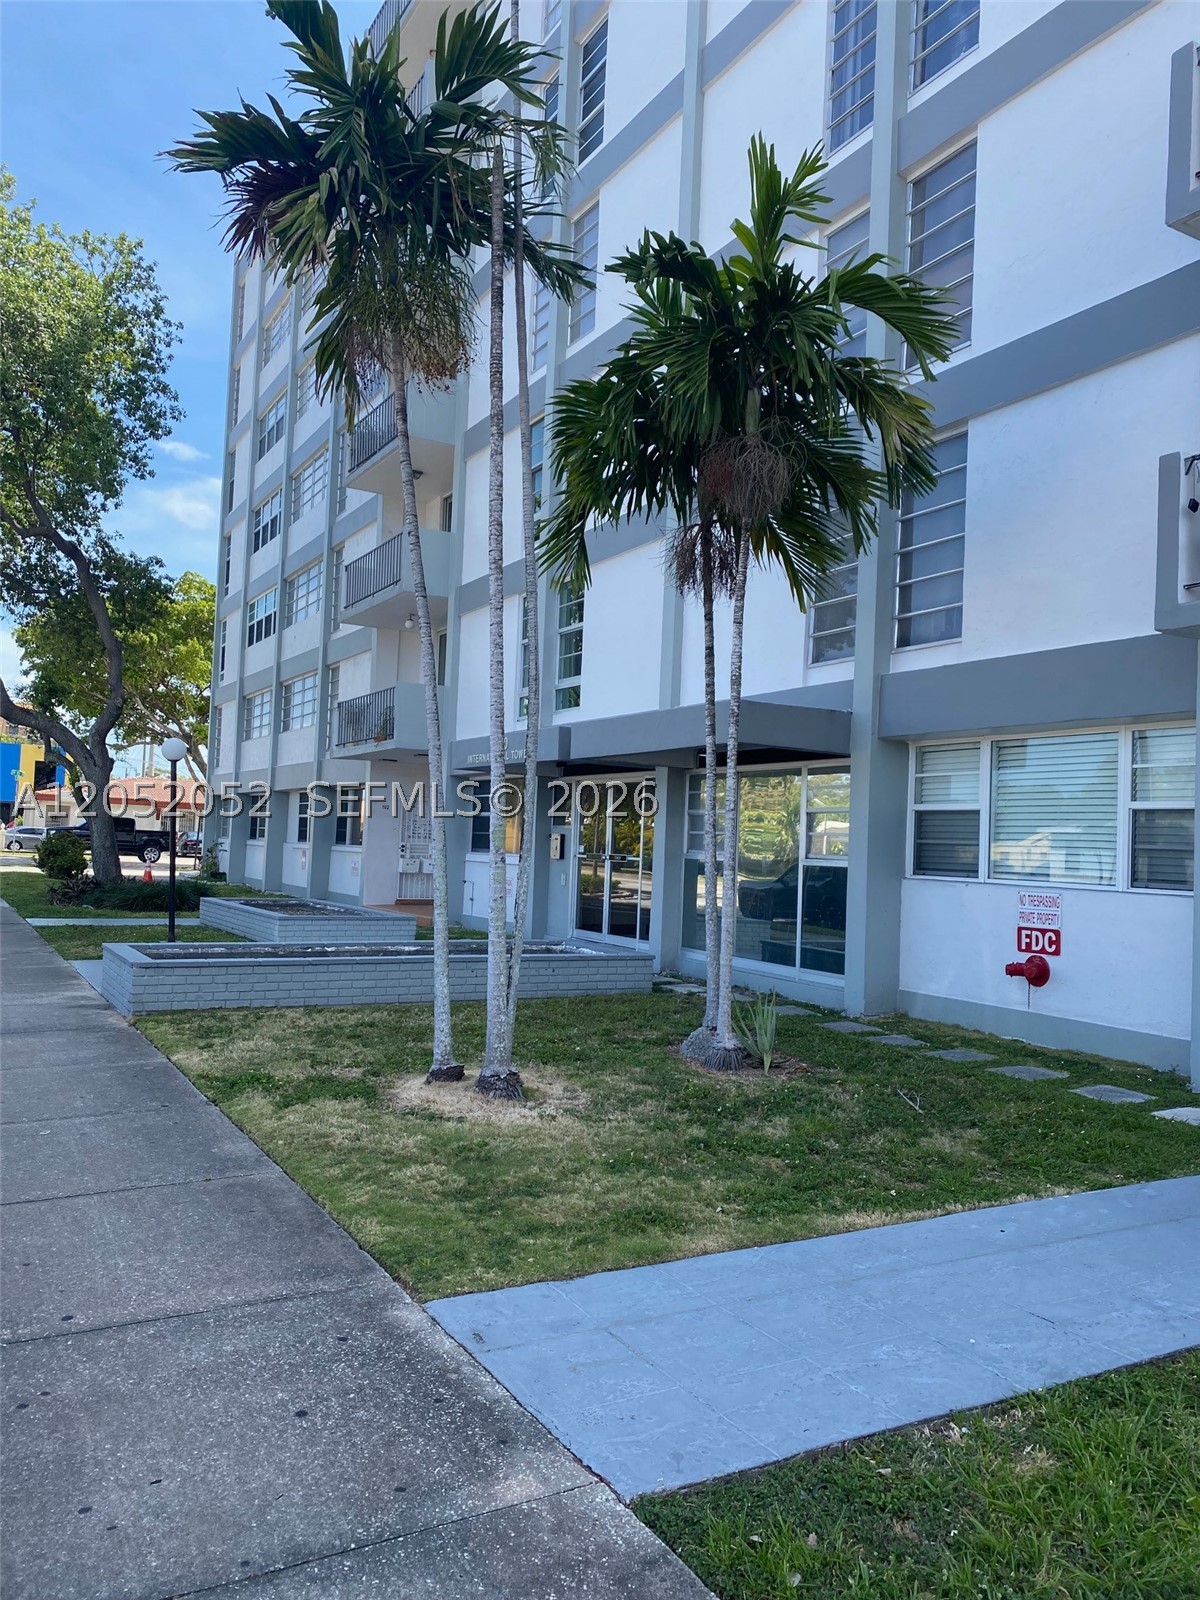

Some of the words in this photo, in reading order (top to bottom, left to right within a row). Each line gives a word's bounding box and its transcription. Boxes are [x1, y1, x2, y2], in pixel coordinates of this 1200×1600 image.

[467, 751, 509, 764] INTERNAL
[1019, 894, 1026, 906] NO
[1028, 894, 1060, 909] TRESPASSING
[1019, 911, 1036, 924] PRIVATE
[1037, 912, 1060, 926] PROPERTY
[1021, 930, 1057, 953] FDC
